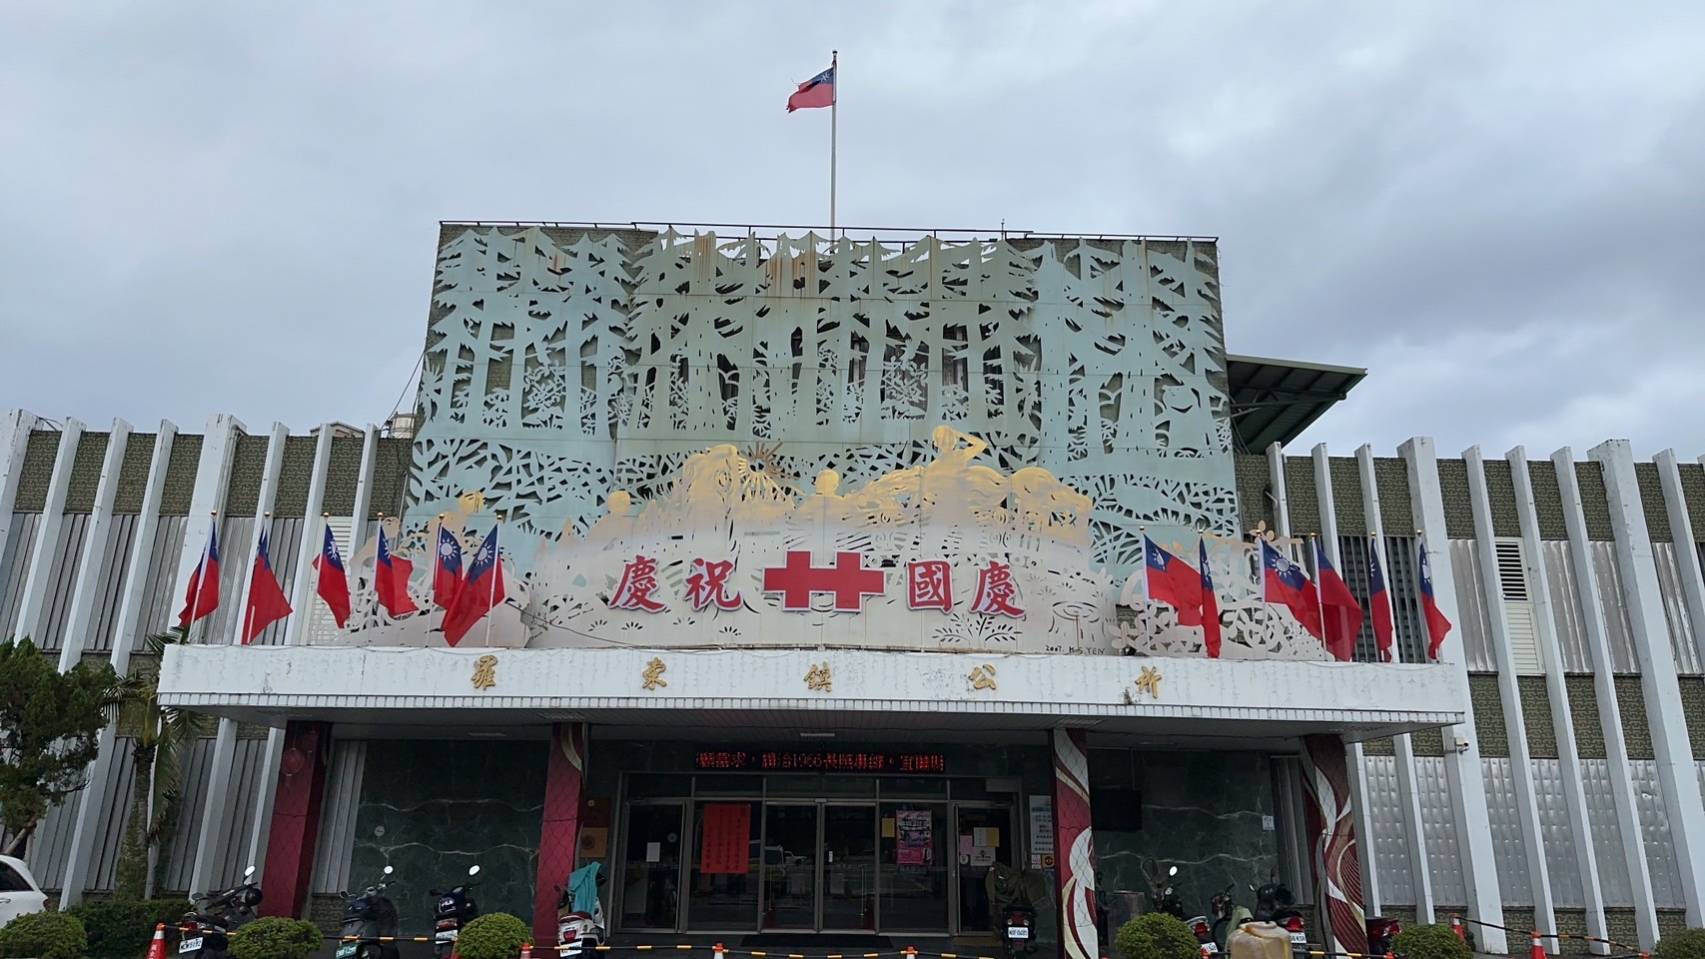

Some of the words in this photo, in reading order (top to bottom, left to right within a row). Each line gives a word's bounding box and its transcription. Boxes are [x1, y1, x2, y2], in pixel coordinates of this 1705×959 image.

[608, 554, 744, 614] 慶祝
[906, 559, 1026, 619] 國慶
[471, 653, 1162, 700] 羅東鎮公所
